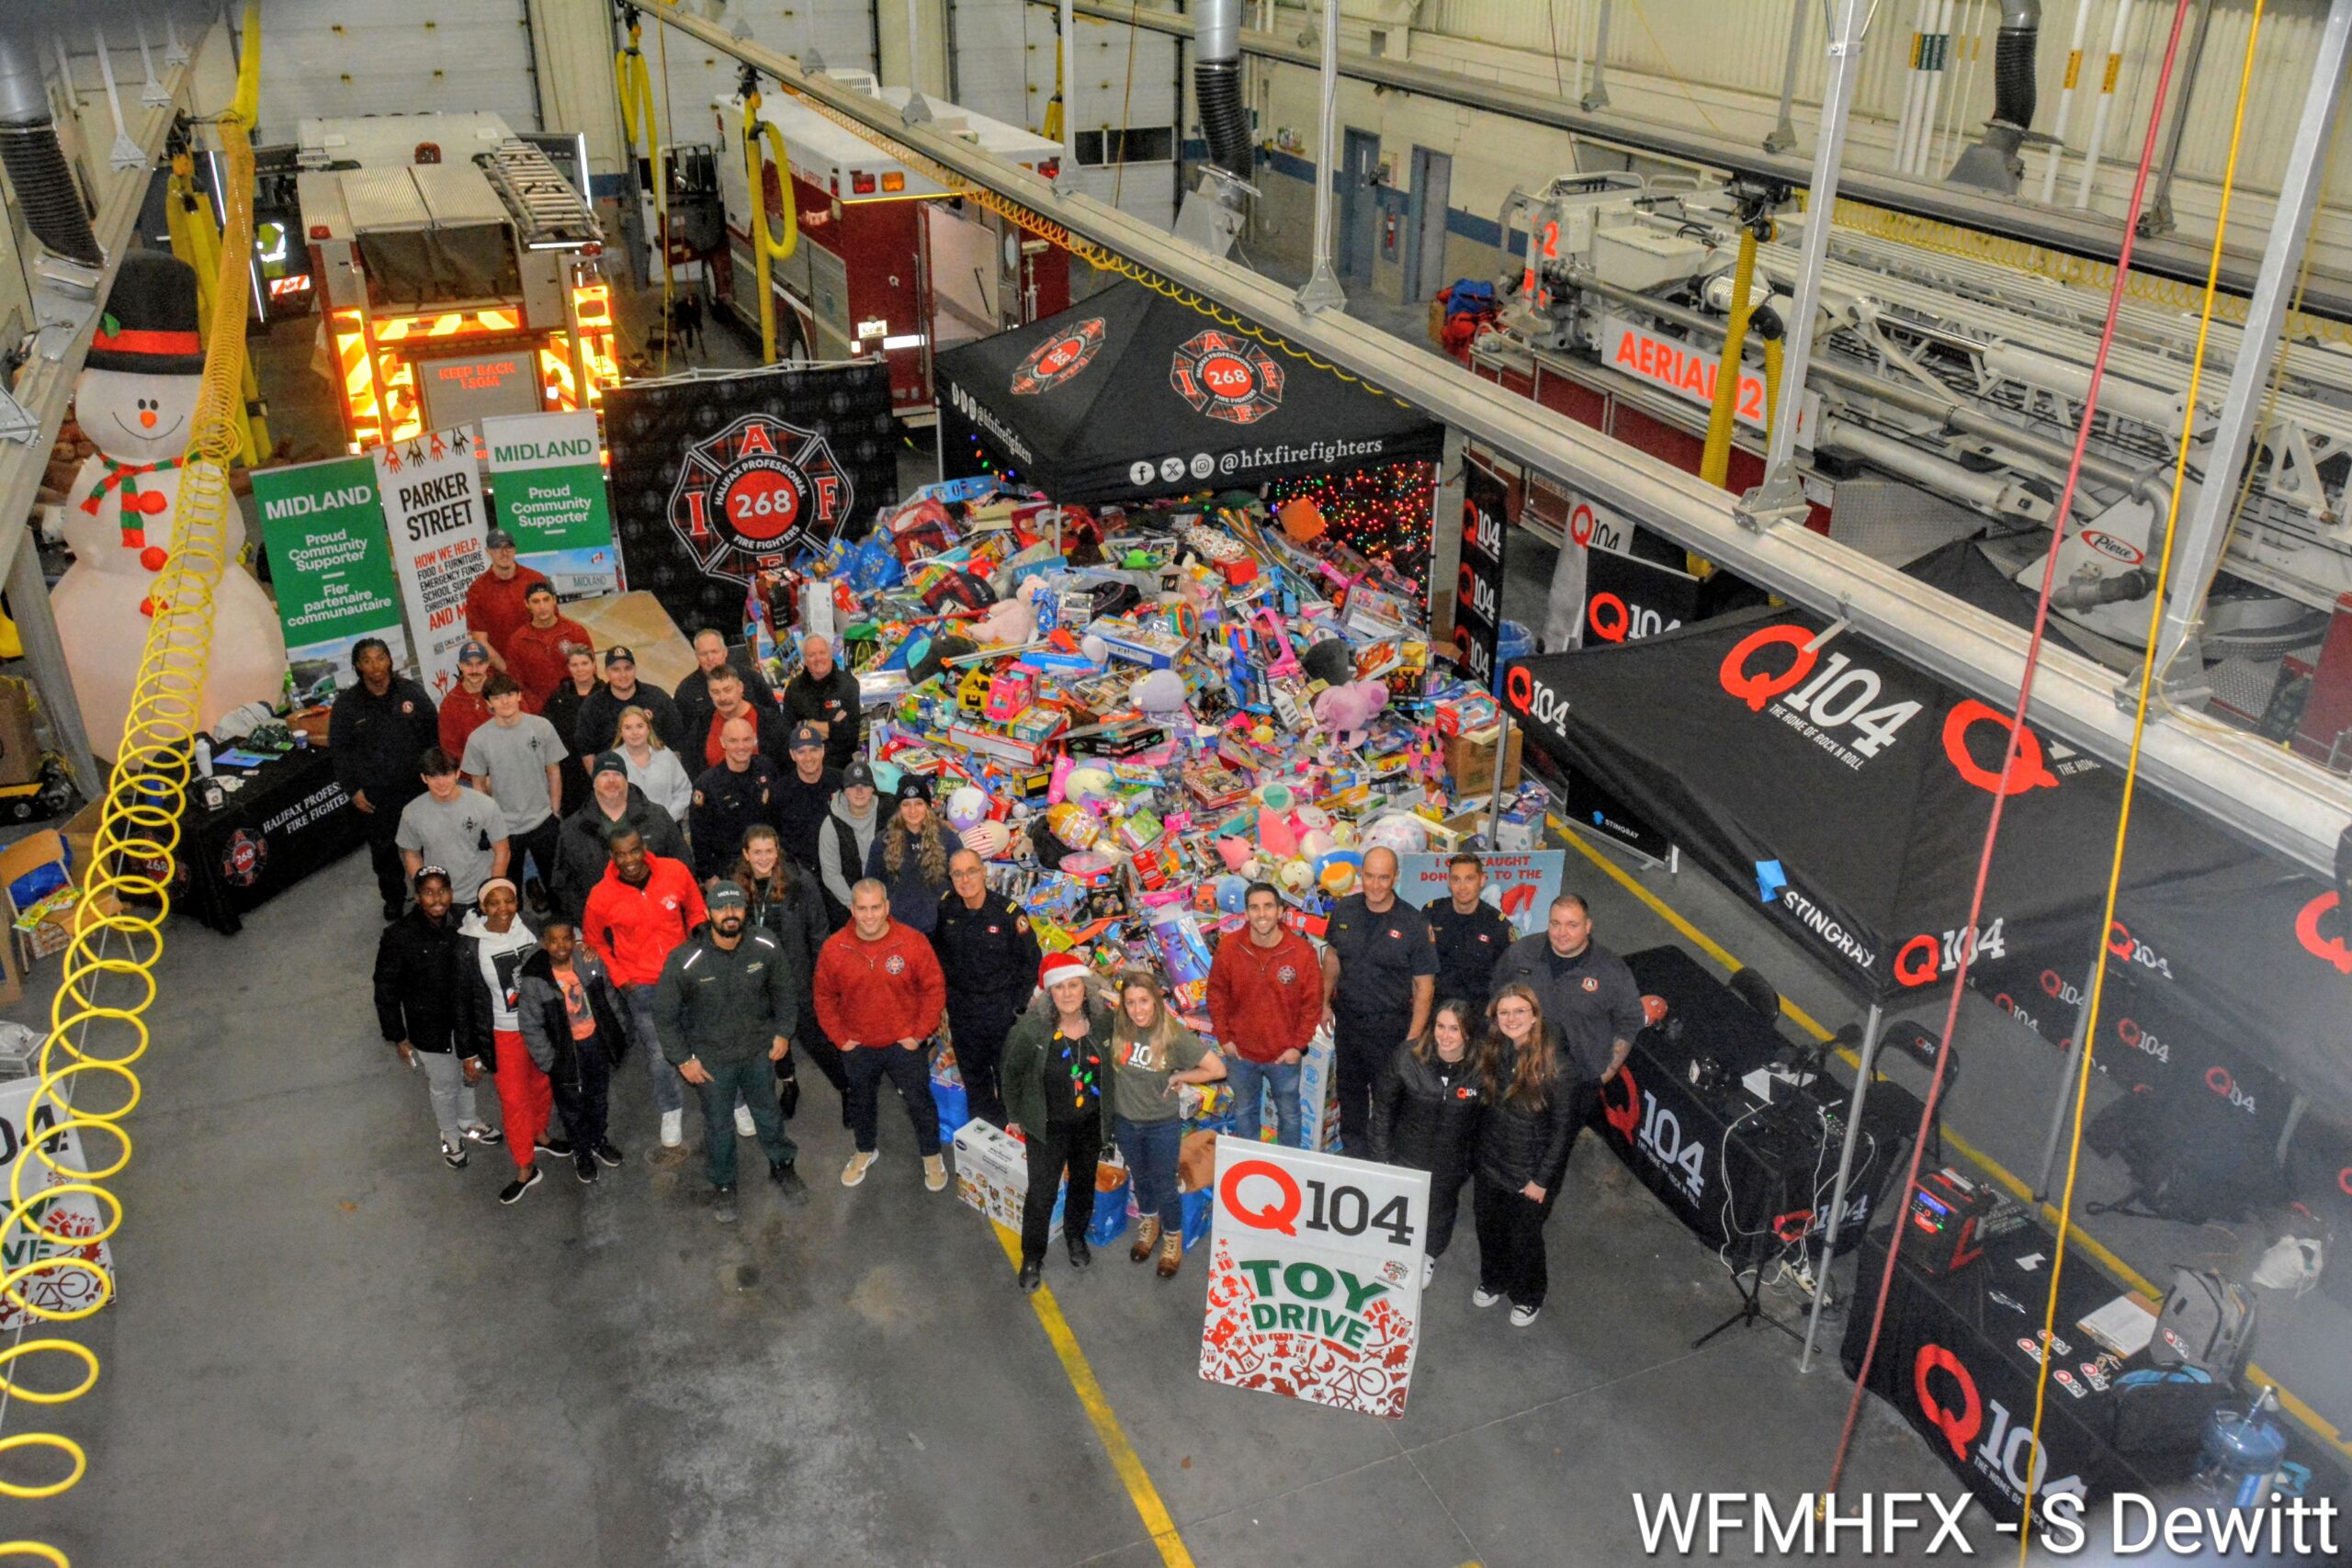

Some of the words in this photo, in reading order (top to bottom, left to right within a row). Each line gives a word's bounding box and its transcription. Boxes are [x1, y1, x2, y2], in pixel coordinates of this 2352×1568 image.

[1209, 368, 1248, 386] 268
[494, 439, 593, 463] MIDLAND
[1219, 439, 1383, 474] @hfxfirefighters
[399, 472, 469, 513] PARKER
[528, 484, 571, 500] Proud
[714, 467, 743, 505] HALIFAX
[741, 458, 808, 498] PROFESSIONAL
[265, 485, 372, 520] MIDLAND
[511, 496, 592, 516] Community
[734, 490, 791, 518] 268
[407, 500, 473, 542] STREET
[517, 510, 589, 529] Supporter
[288, 536, 368, 563] Community
[305, 529, 347, 547] Proud
[733, 535, 756, 549] FIRE
[755, 525, 801, 549] FIGHTERS
[295, 551, 366, 572] Supporter
[414, 551, 436, 570] HOW
[437, 545, 453, 562] WE
[454, 537, 481, 556] HELP:
[417, 567, 436, 581] FOOD
[444, 551, 483, 570] FURNITURE
[322, 581, 350, 597] Fier
[420, 570, 460, 592] EMERGENCY
[461, 562, 485, 578] FUNDS
[304, 589, 373, 615] partenaire
[423, 584, 451, 604] SCHOOL
[288, 596, 392, 628] communautaire
[429, 607, 454, 631] AND
[1508, 665, 1570, 738] Q104
[1719, 624, 1923, 760] Q104
[1769, 703, 1787, 718] THE
[1782, 712, 1808, 731] HOME
[1803, 724, 1819, 738] OF
[1813, 733, 1838, 753] ROCK
[1840, 749, 1864, 771] ROLL
[2057, 762, 2076, 776] THE
[262, 802, 303, 834] HALIFAX
[303, 782, 341, 808] PROFES
[286, 815, 310, 834] FIRE
[1604, 817, 1639, 840] STINGRAY
[235, 848, 254, 865] 268
[1495, 870, 1512, 880] TO
[1518, 869, 1543, 880] THE
[1783, 890, 1875, 968] STINGRAY
[1894, 918, 2005, 987] Q104
[2118, 1018, 2169, 1064] Q104
[1600, 1066, 1705, 1199] Q104
[1220, 1159, 1414, 1247] Q104
[1238, 1259, 1390, 1314] TOY
[1250, 1303, 1373, 1350] DRIVE
[1988, 1471, 2012, 1497] HOME
